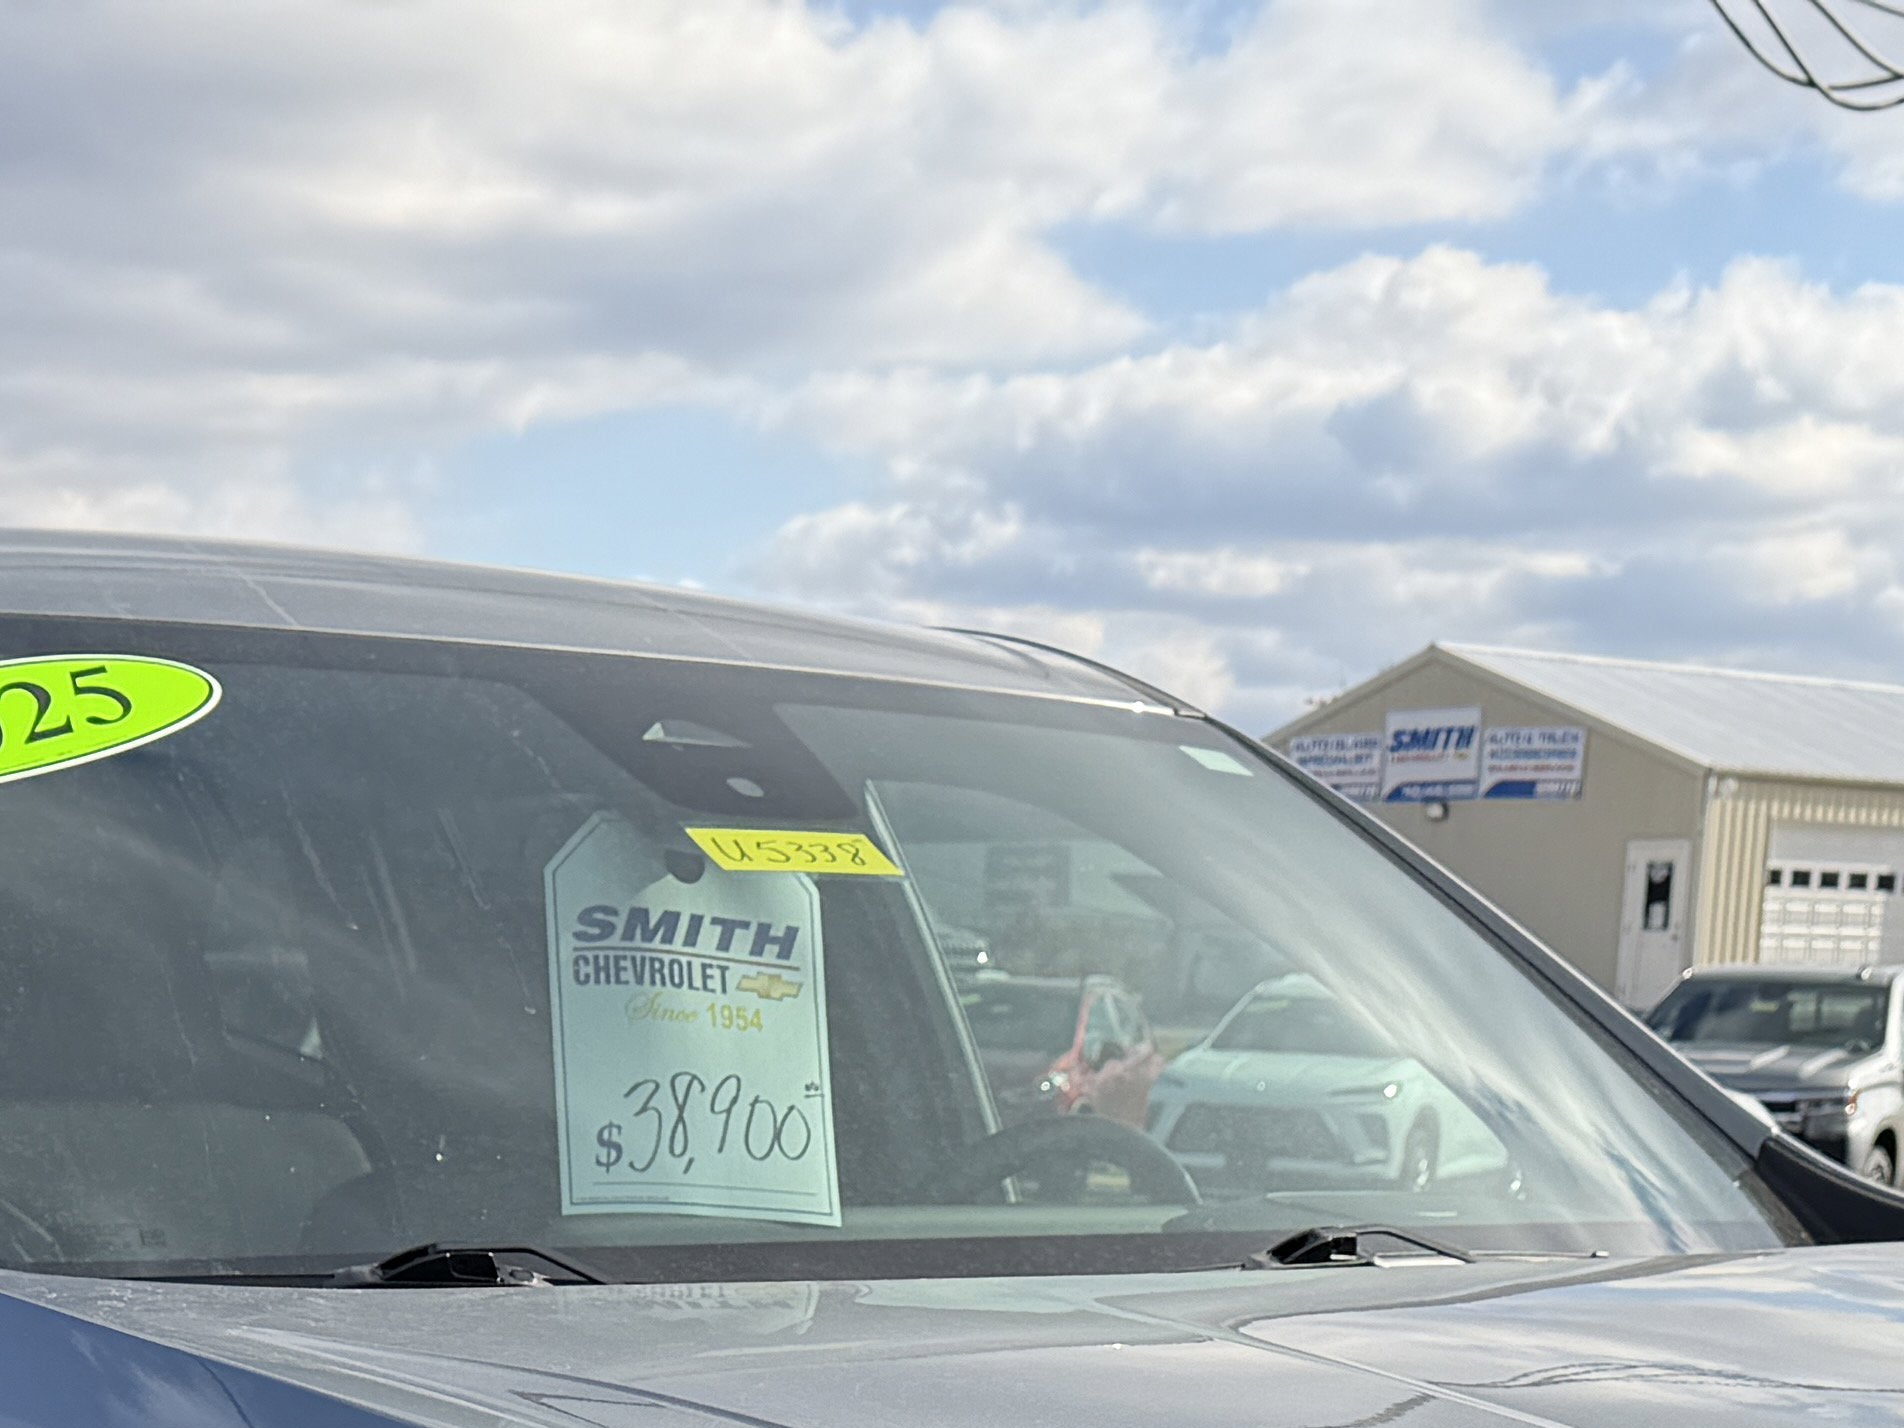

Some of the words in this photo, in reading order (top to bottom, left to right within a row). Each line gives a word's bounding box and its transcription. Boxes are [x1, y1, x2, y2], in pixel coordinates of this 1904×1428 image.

[1390, 726, 1475, 752] SMITH
[572, 904, 801, 962] SMITH
[573, 954, 731, 995] CHEVROLET
[624, 991, 700, 1026] Since
[707, 1002, 764, 1033] 1954
